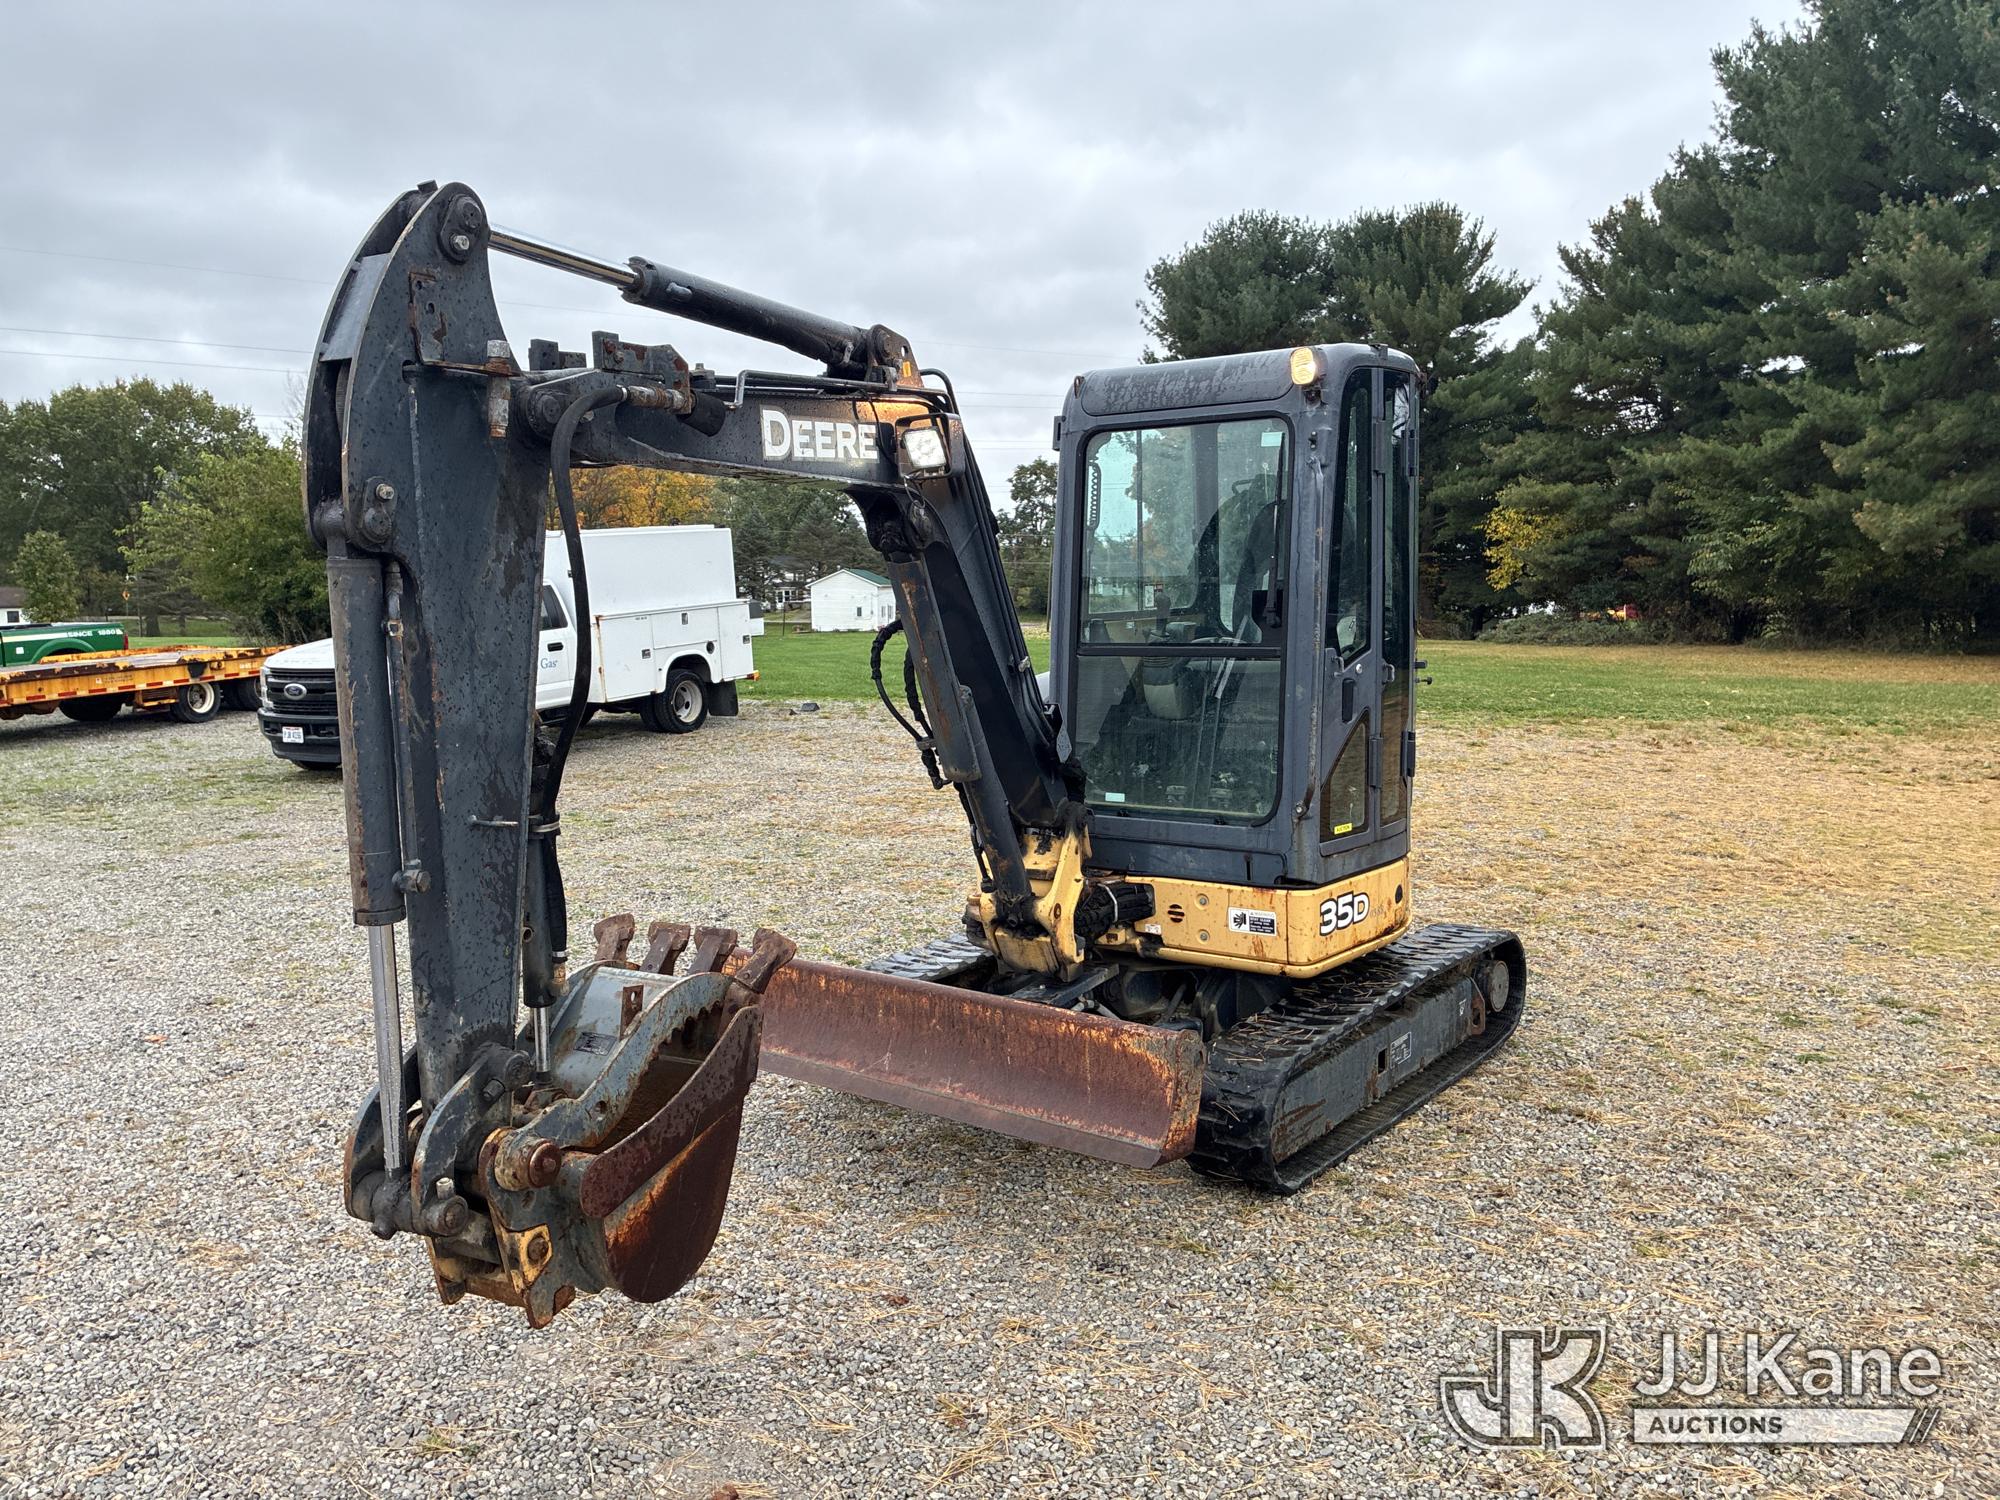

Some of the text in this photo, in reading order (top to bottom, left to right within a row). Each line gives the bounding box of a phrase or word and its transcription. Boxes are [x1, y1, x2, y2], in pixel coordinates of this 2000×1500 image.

[762, 409, 878, 460] DEERE
[69, 630, 93, 638] SINCE
[540, 657, 556, 670] Gas
[1320, 891, 1370, 936] 35D
